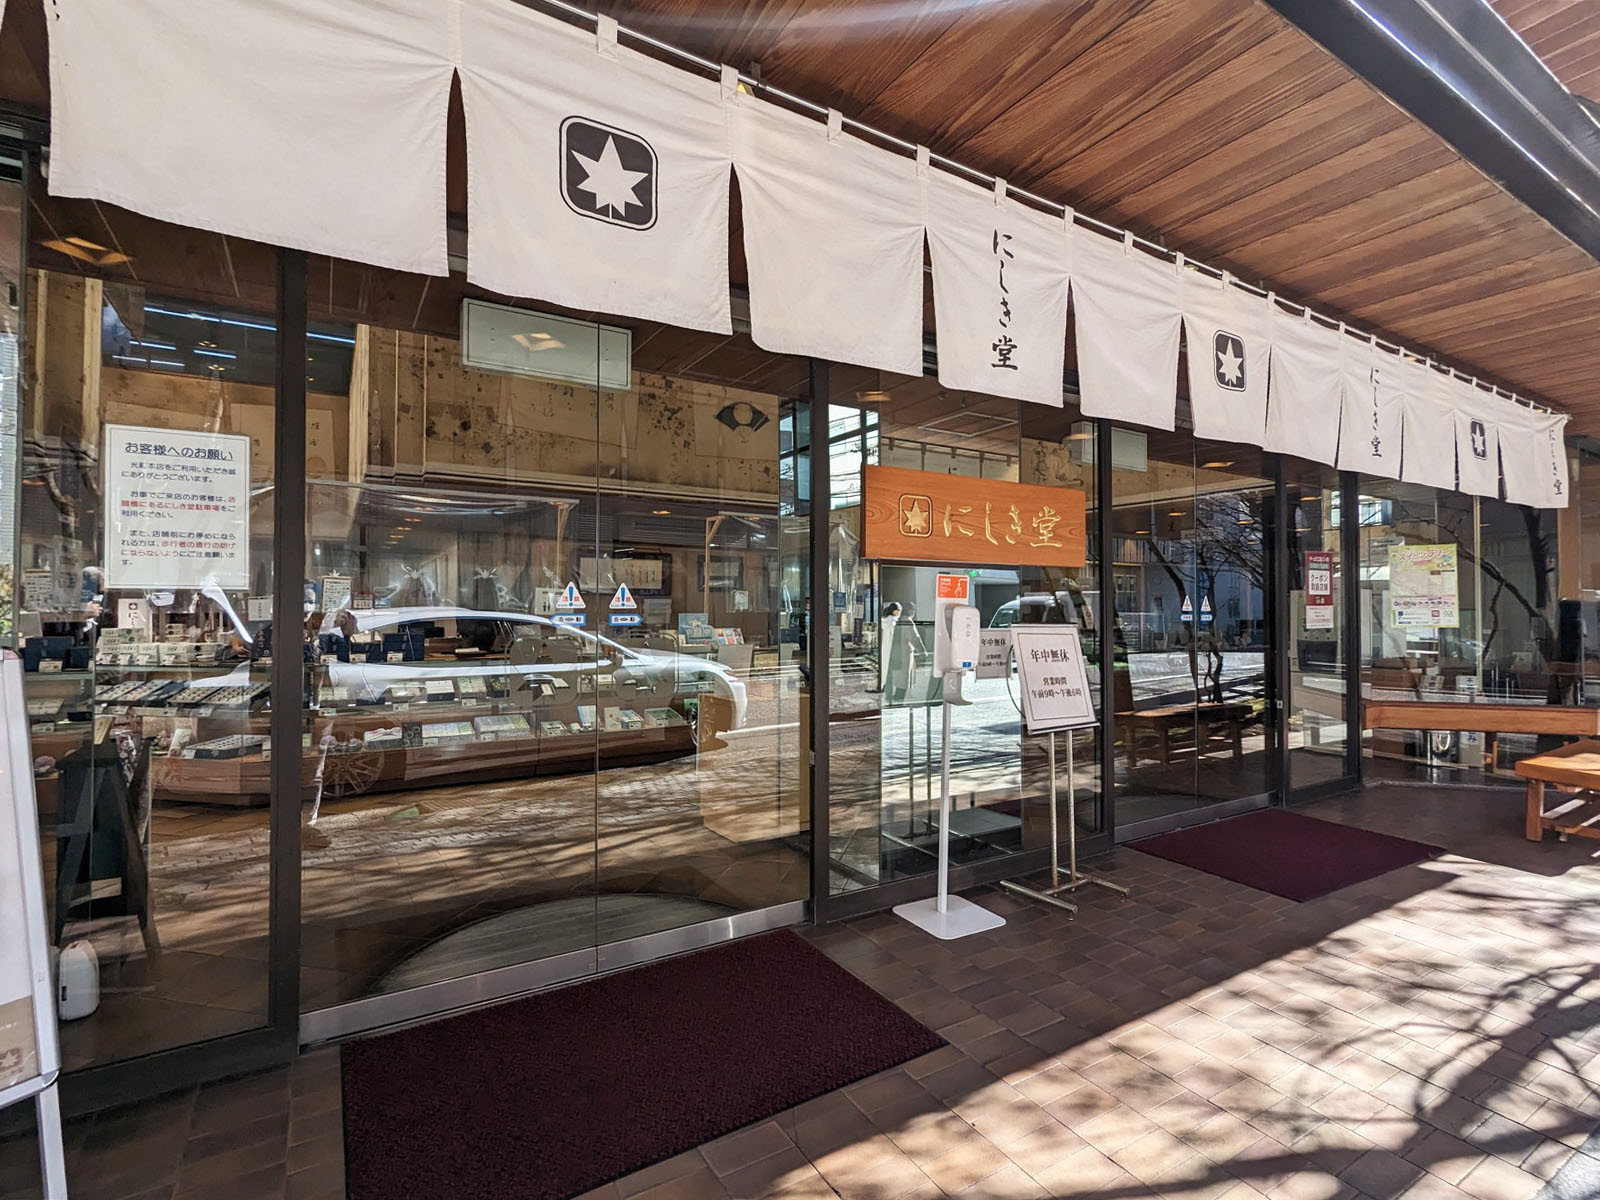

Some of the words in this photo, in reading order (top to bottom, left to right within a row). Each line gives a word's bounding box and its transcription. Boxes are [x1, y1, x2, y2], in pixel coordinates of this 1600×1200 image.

[991, 228, 1018, 370] にしき堂
[1369, 367, 1382, 457] にしき堂
[125, 441, 234, 461] お客様へのお願い
[943, 502, 1063, 547] にしき堂
[1031, 648, 1070, 663] 年中無休
[1042, 676, 1068, 686] 営業時間
